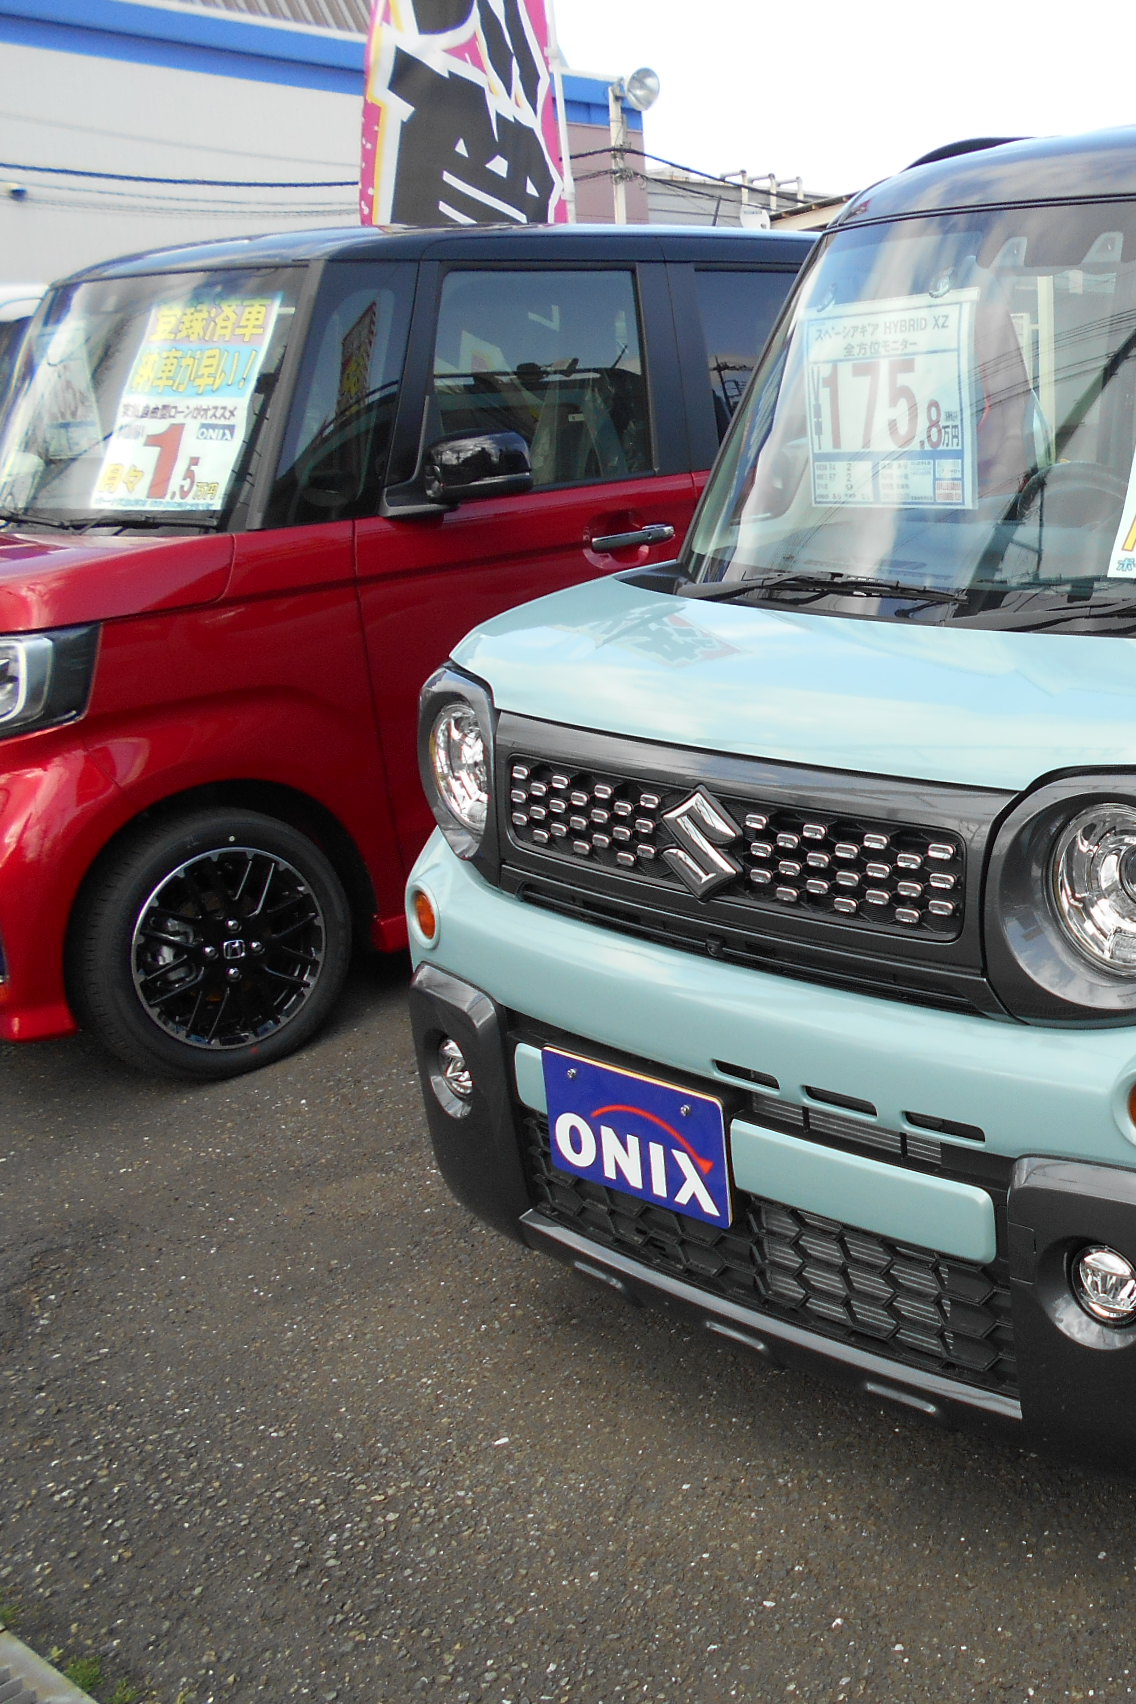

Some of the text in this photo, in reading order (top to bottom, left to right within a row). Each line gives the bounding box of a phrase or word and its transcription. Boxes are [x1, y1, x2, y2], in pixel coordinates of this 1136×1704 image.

[883, 317, 927, 335] HYBRID
[932, 314, 950, 329] XZ
[555, 1112, 721, 1217] ONIX
